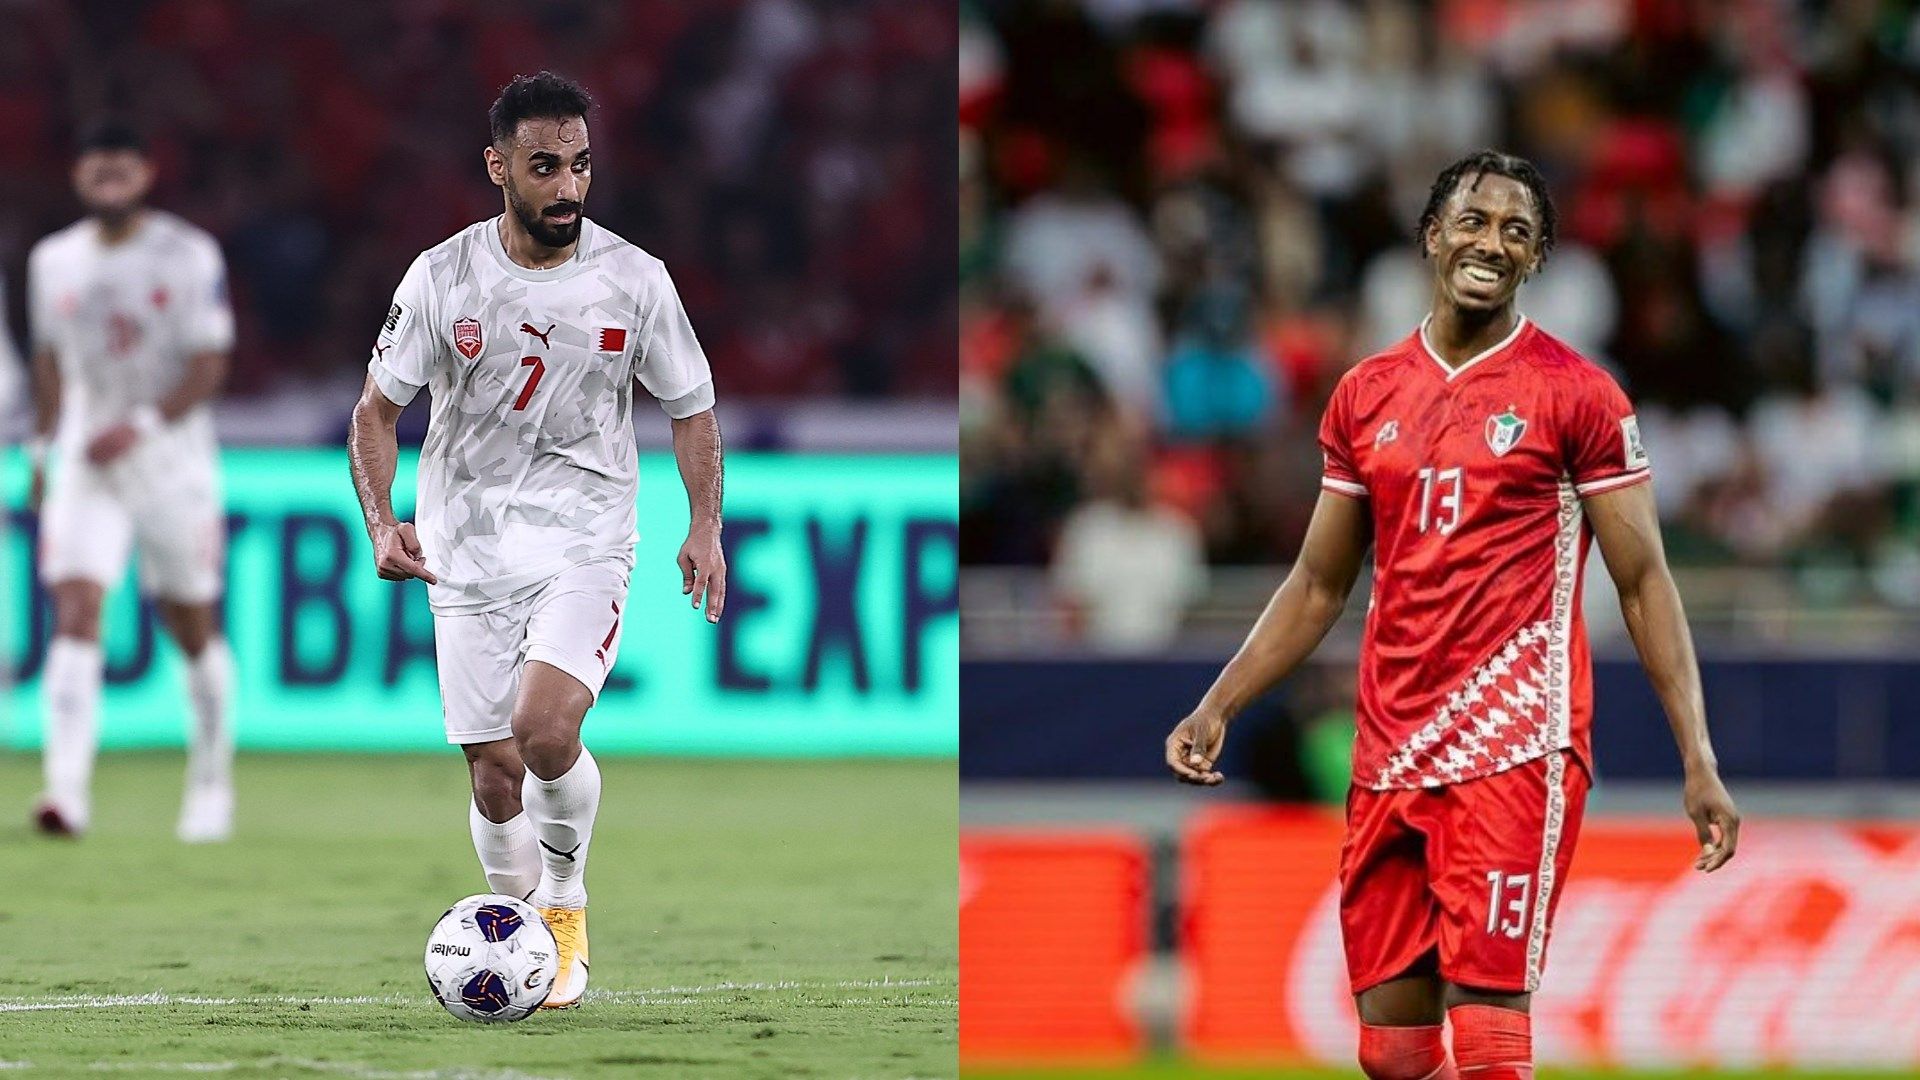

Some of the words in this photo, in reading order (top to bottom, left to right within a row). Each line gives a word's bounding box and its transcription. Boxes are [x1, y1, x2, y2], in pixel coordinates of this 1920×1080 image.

[513, 356, 545, 410] 7
[1417, 466, 1462, 535] 13
[1486, 869, 1531, 938] 13
